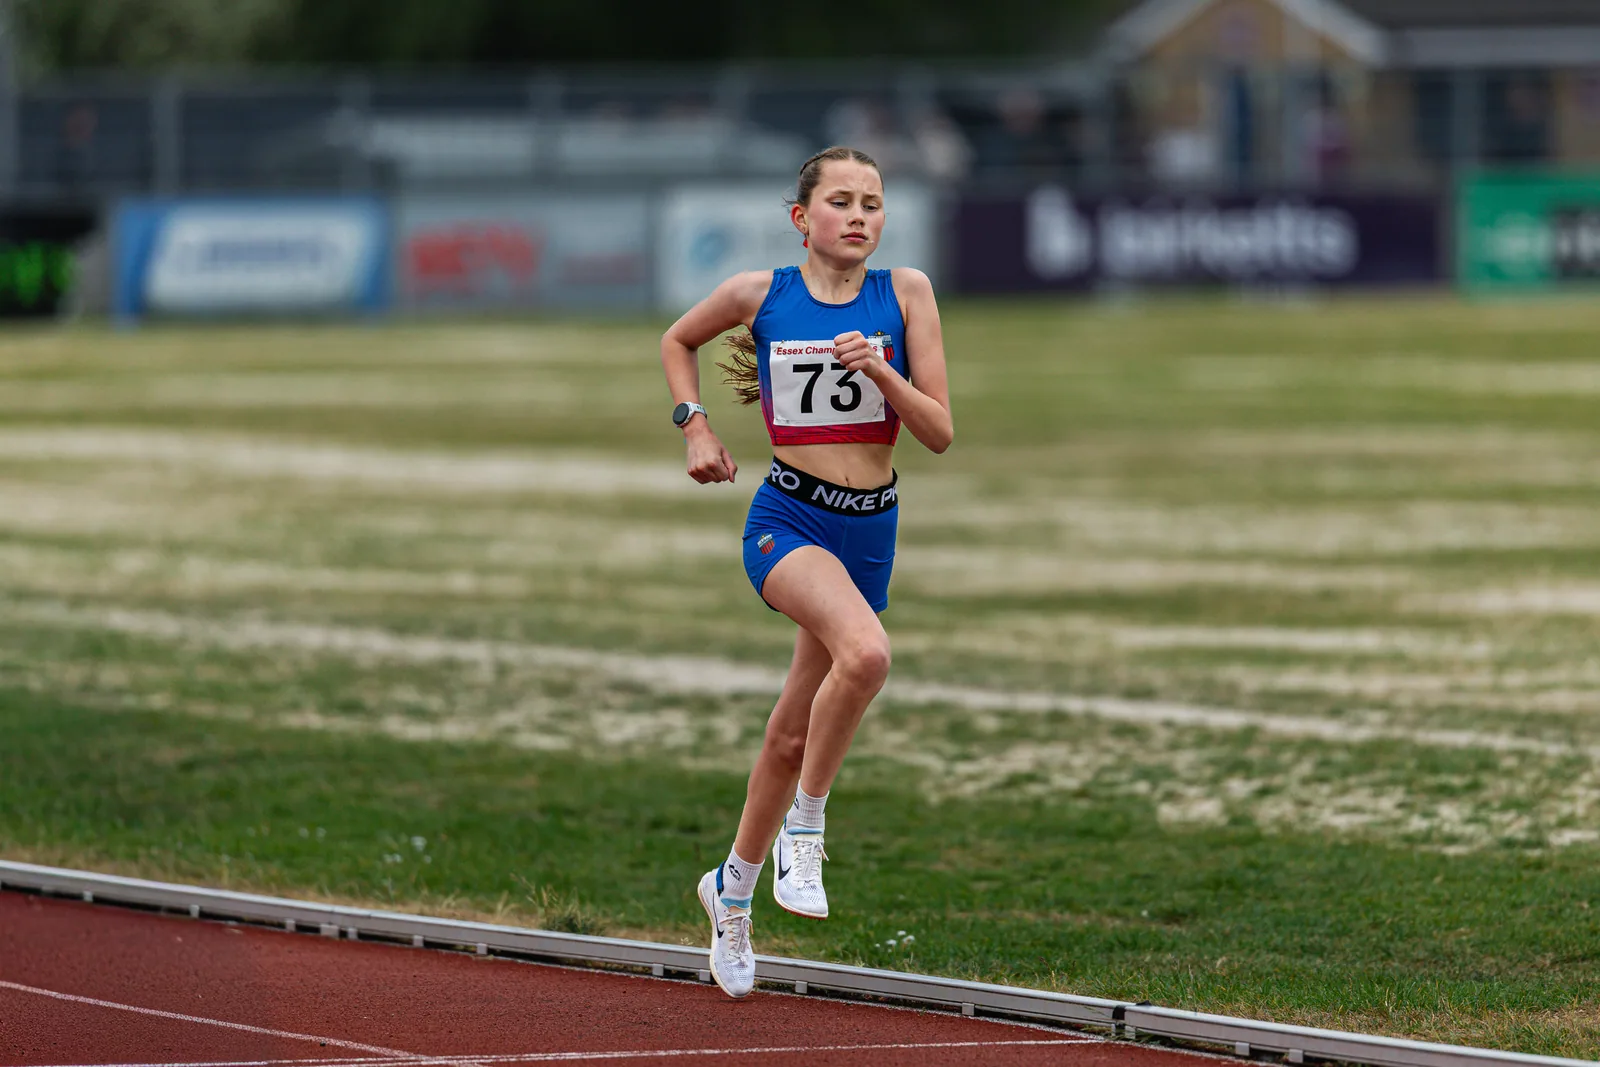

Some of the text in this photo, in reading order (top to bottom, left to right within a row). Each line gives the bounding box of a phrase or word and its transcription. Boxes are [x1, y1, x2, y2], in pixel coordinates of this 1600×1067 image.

[776, 346, 804, 356] Essex
[793, 363, 862, 413] 73
[811, 485, 878, 511] NIKE
